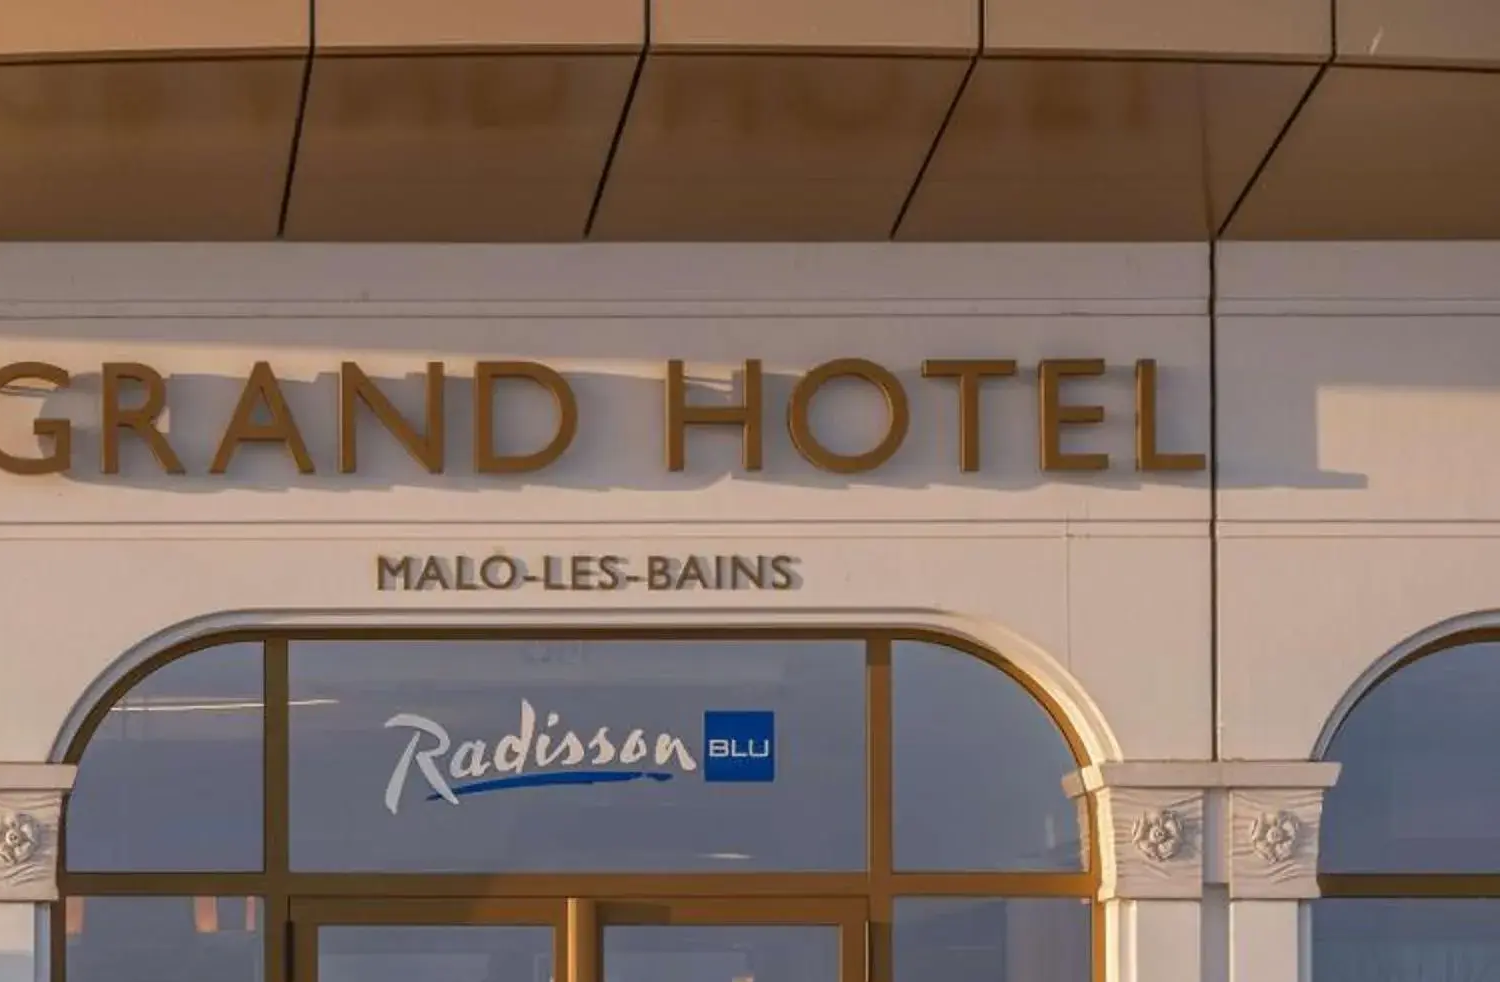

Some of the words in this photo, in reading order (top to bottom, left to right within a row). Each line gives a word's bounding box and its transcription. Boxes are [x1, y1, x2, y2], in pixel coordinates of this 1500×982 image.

[665, 358, 1206, 472] HOTEL
[376, 554, 796, 592] MALO-LES-BAINS
[384, 698, 697, 815] Radisson
[708, 738, 770, 758] BLU
